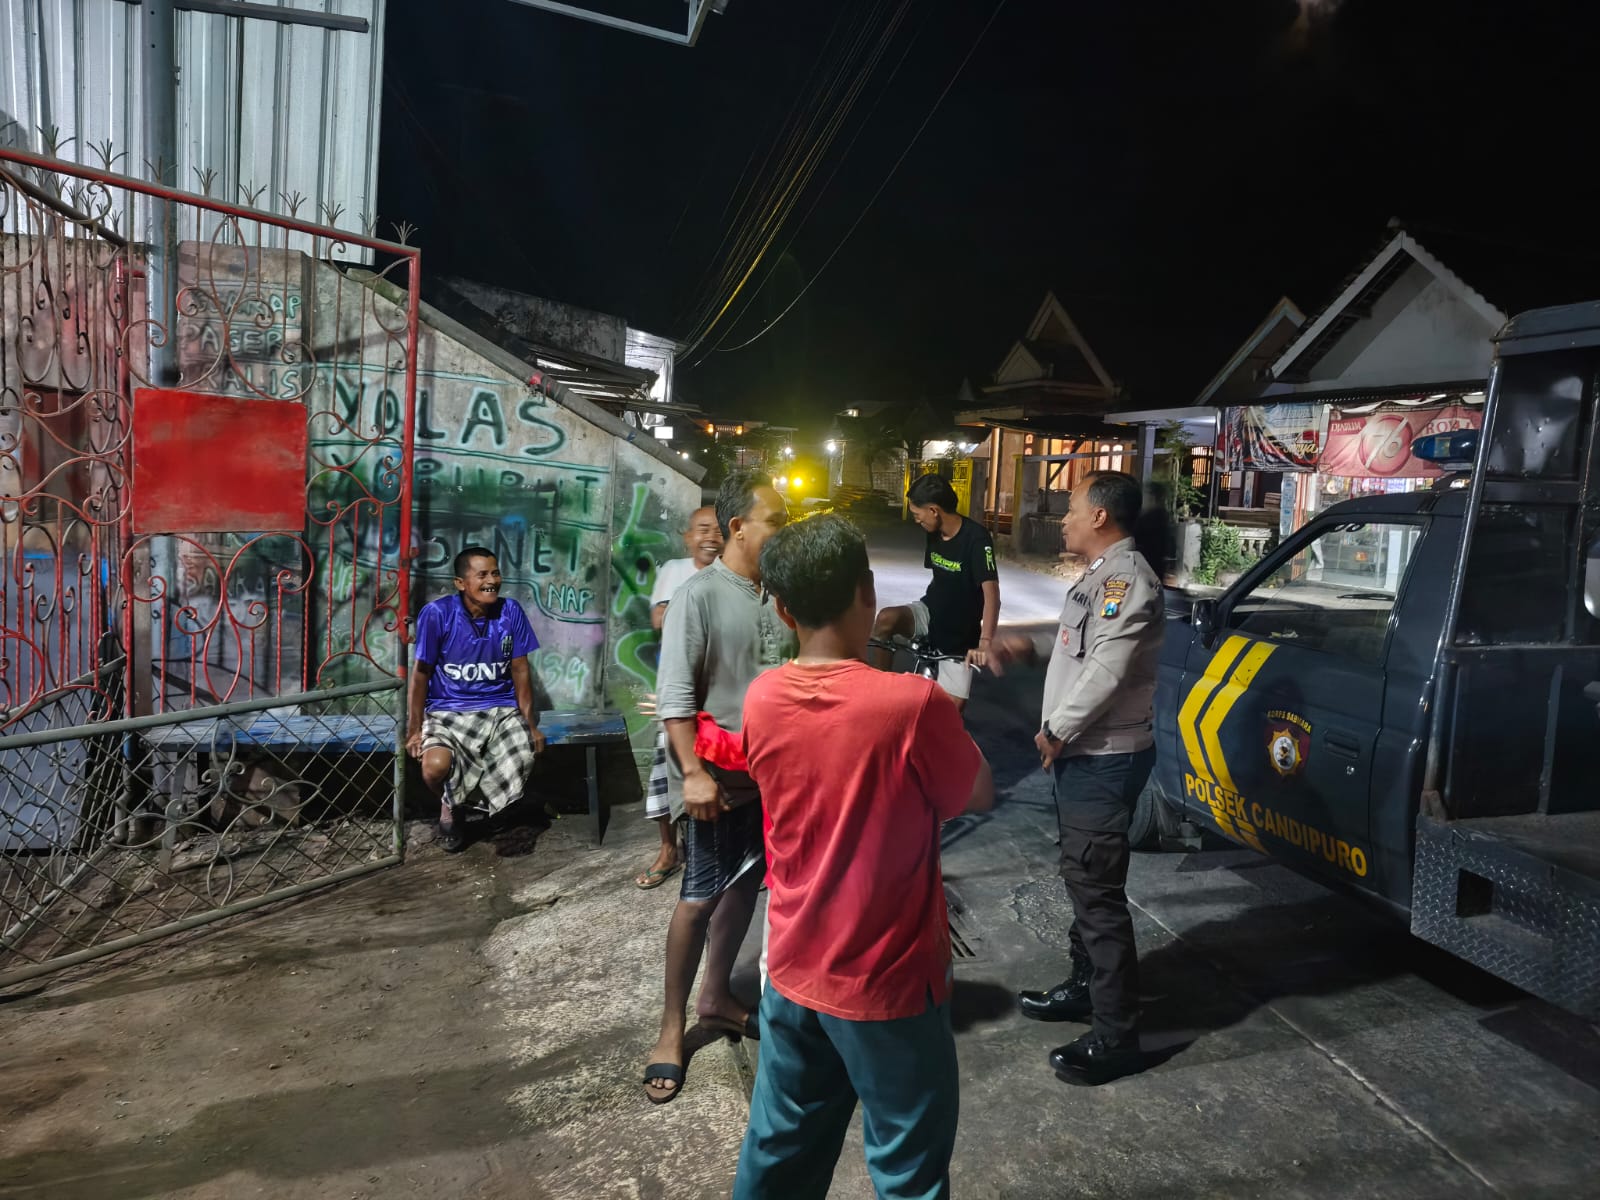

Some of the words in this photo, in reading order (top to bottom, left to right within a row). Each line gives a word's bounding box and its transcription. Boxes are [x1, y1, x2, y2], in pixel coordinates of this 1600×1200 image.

[443, 659, 511, 682] SONY
[1184, 772, 1249, 822] POLSEK
[1250, 802, 1367, 877] CANDIPURO
